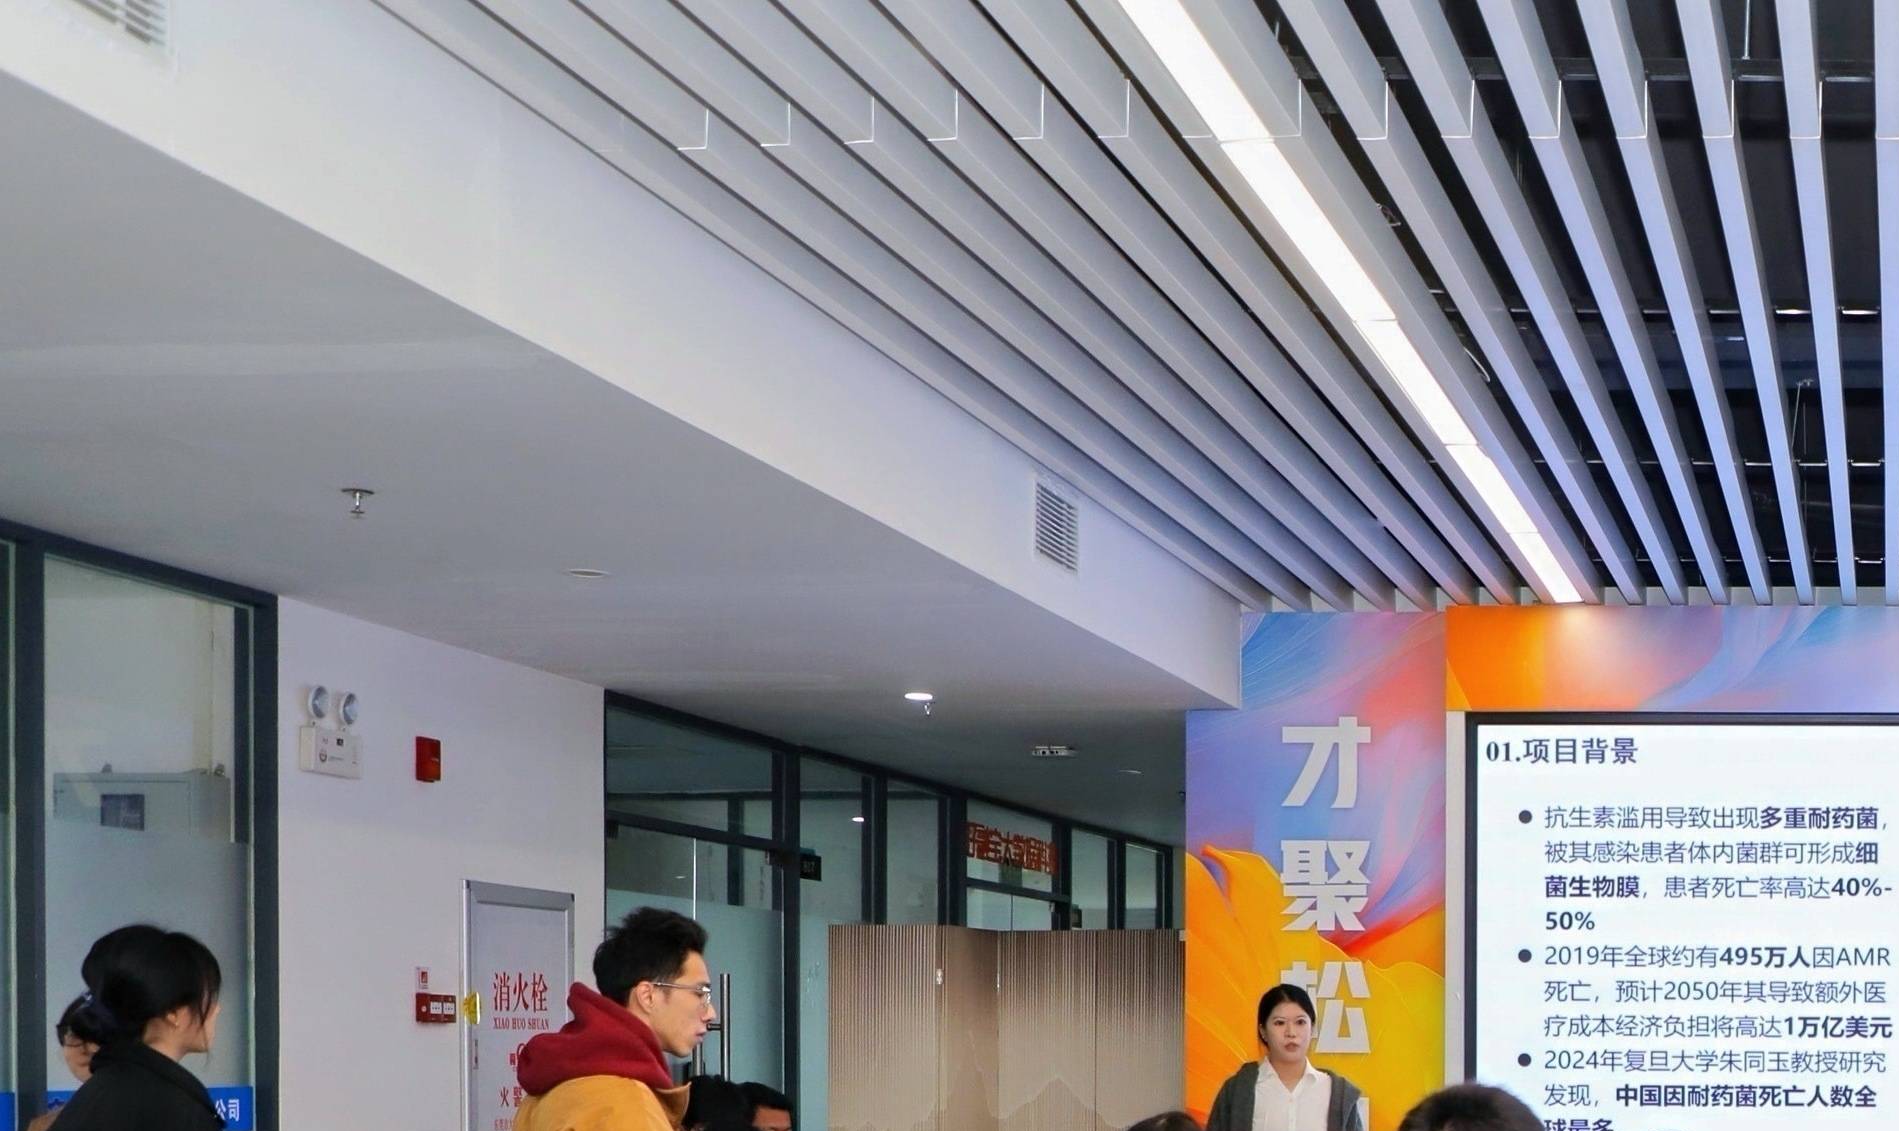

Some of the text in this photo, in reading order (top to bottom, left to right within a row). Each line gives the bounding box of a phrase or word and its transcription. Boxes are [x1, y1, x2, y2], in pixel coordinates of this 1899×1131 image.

[1487, 738, 1638, 764] 01.项目背景
[1545, 806, 1887, 829] 抗生素滥用导致出现多重耐药菌，
[1545, 841, 1878, 864] 被其感染患者体内菌群可形成细
[1545, 875, 1892, 898] 菌生物膜，患者死亡率高达40%-
[1546, 912, 1595, 930] 50%
[1545, 945, 1890, 968] 2019年全球约有495万人因AMR
[493, 972, 548, 1013] 消火栓
[1545, 980, 1885, 1003] 死亡，预计2050年其导致额外医
[493, 1018, 549, 1030] XIAO HUO SHUAN
[1545, 1015, 1892, 1038] 疗成本经济负担将高达1万亿美元
[1545, 1050, 1886, 1073] 2024年复旦大学朱同玉教授研究
[1545, 1084, 1876, 1107] 发现，中国因耐药菌死亡人数全
